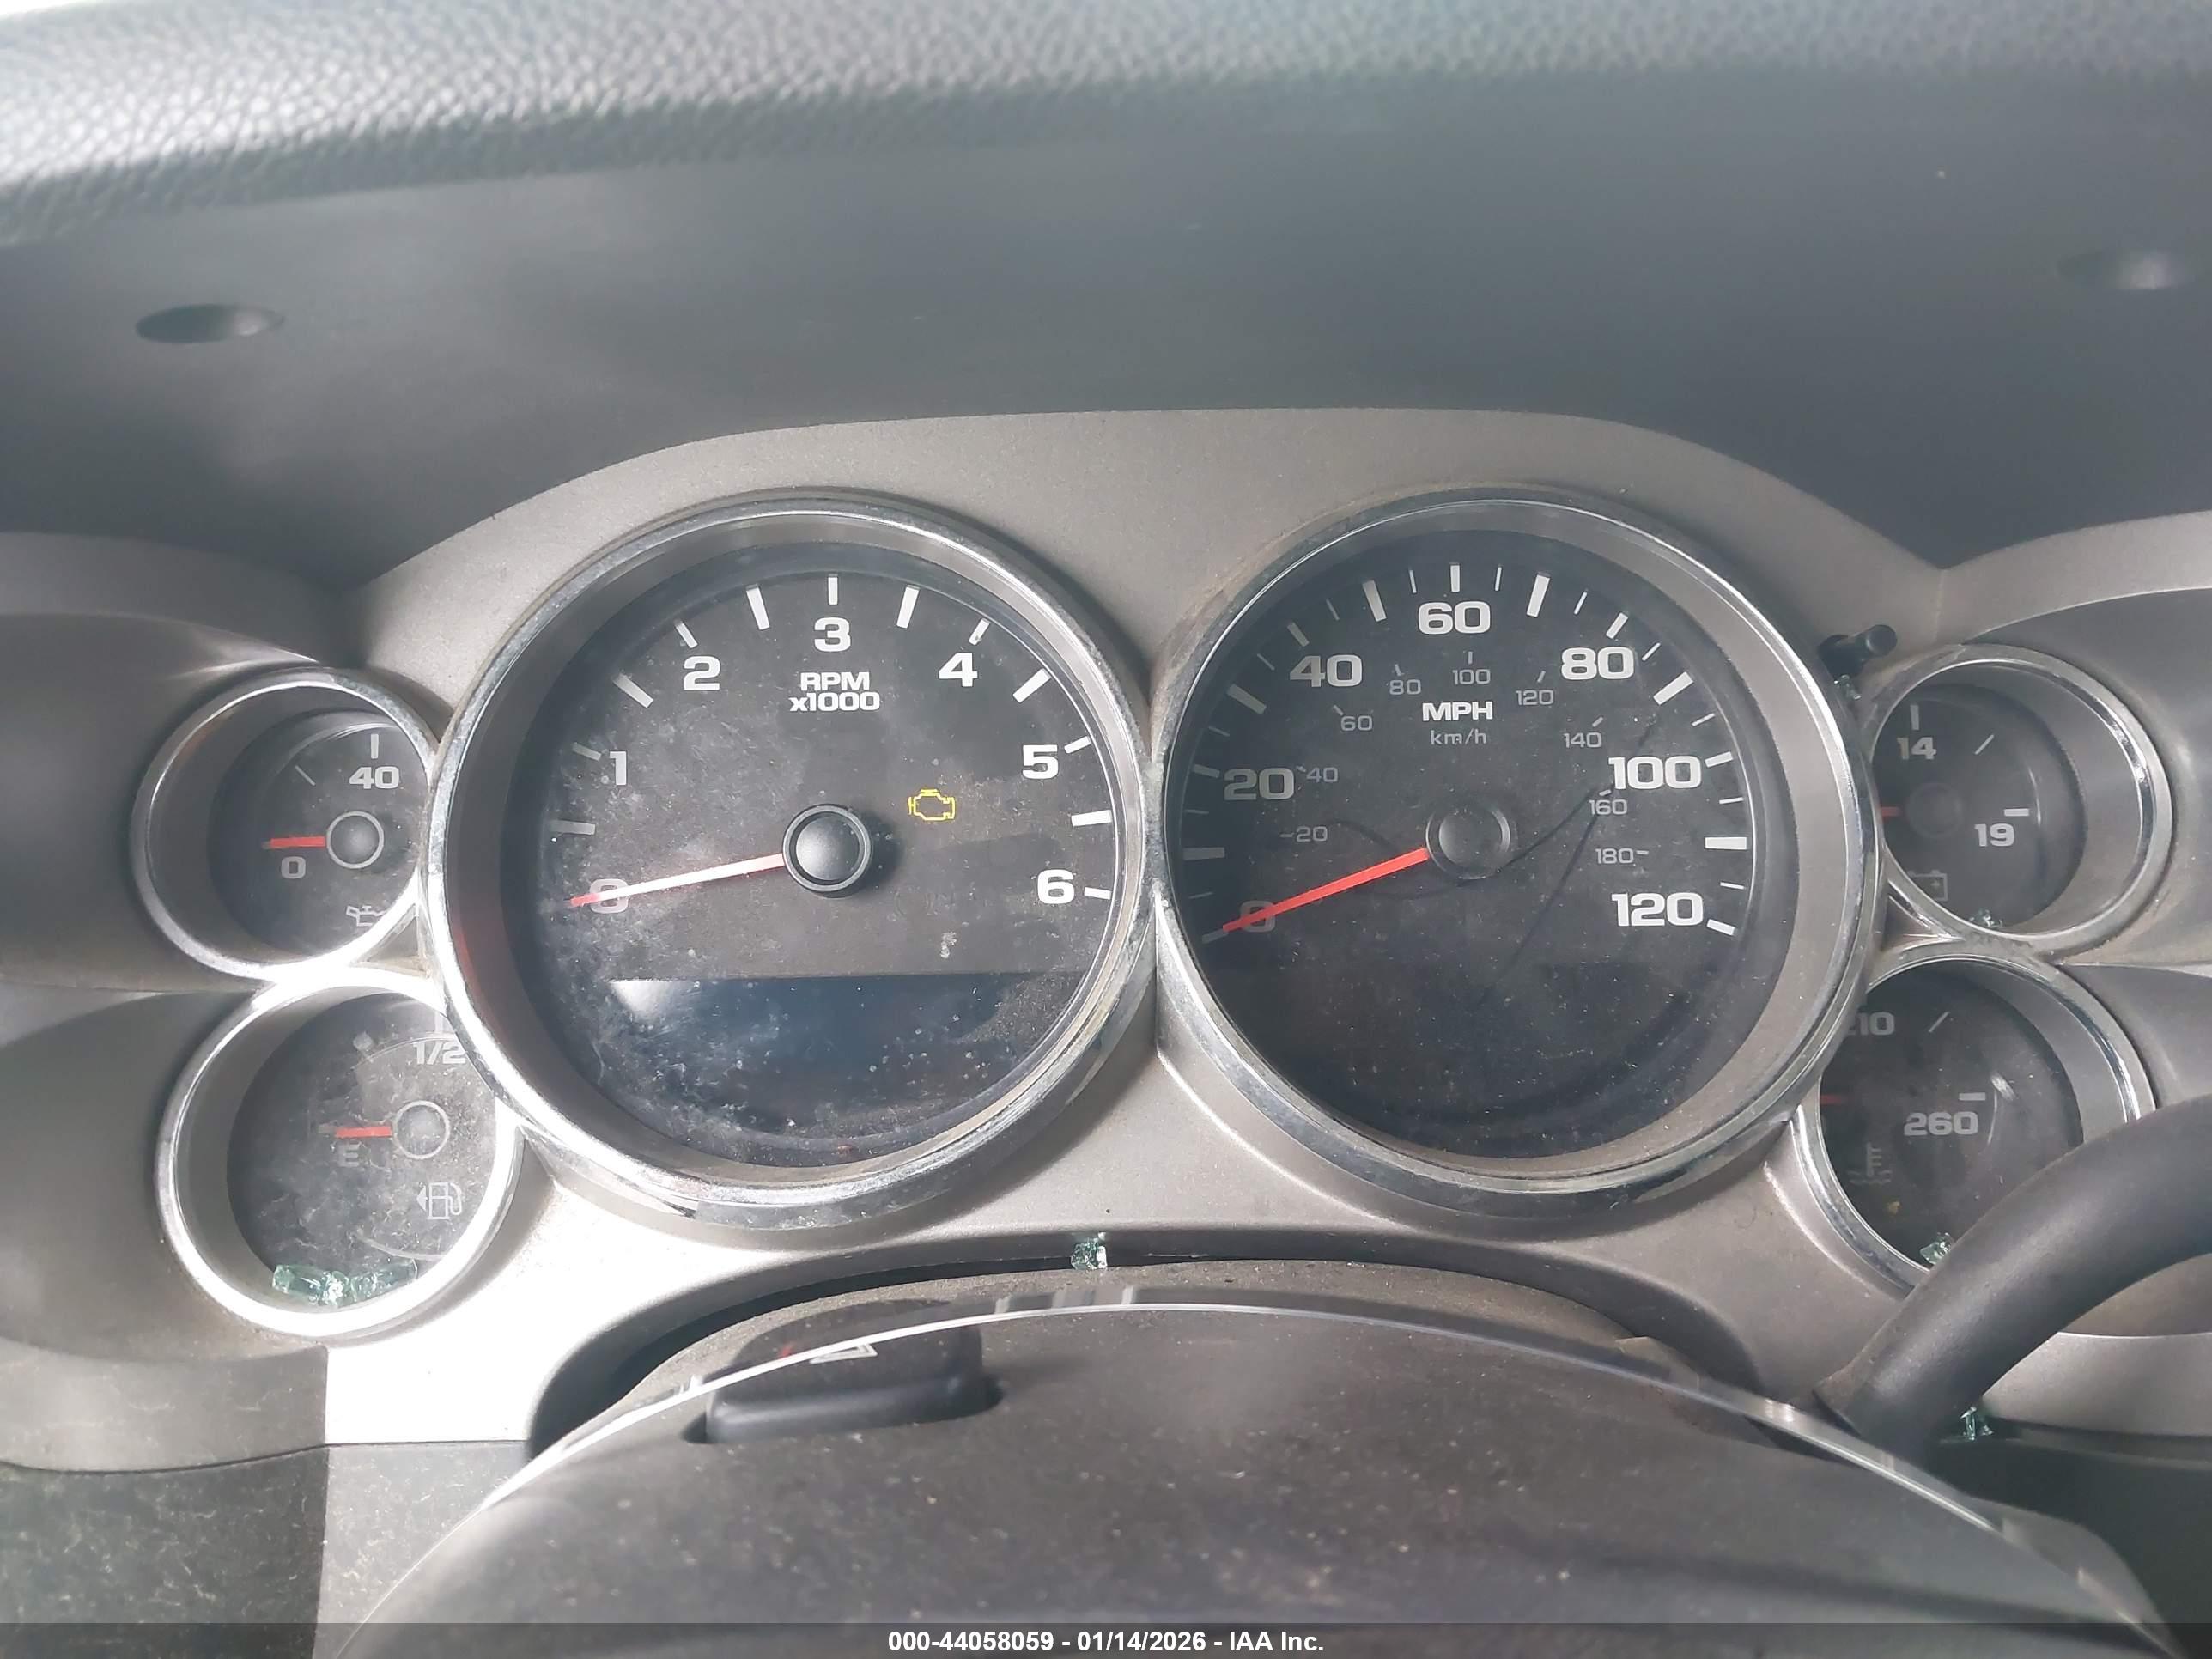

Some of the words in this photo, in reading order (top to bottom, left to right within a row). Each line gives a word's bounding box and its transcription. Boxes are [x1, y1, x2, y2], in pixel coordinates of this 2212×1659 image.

[1418, 601, 1492, 635] 60
[814, 617, 852, 652] 3
[684, 655, 720, 690] 2
[939, 653, 978, 687] 4
[1290, 654, 1363, 688] 40
[1561, 646, 1635, 680] 80
[800, 672, 870, 691] RPM
[1389, 678, 1422, 696] 80
[1452, 669, 1491, 686] 100
[789, 692, 881, 712] x1000
[1516, 690, 1554, 706] 120
[1340, 714, 1372, 732] 60
[1422, 702, 1493, 721] MPH
[1430, 728, 1487, 745] km/h
[1564, 732, 1601, 749] 140
[1897, 736, 1937, 760] 14
[610, 750, 627, 785] 1
[1022, 744, 1060, 779] 5
[1608, 755, 1702, 790] 100
[349, 766, 400, 790] 40
[1224, 767, 1295, 801] 20
[1305, 766, 1338, 783] 40
[1589, 799, 1627, 816] 160
[1296, 826, 1328, 842] 20
[1974, 823, 2014, 847] 19
[281, 856, 306, 879] 0
[1595, 848, 1634, 864] 180
[590, 878, 629, 914] 0
[1037, 869, 1075, 904] 6
[1239, 900, 1276, 933] 0
[1611, 893, 1704, 927] 120
[1848, 1012, 1896, 1036] 10
[413, 1041, 468, 1065] 1/2
[1903, 1111, 1979, 1136] 260
[337, 1142, 360, 1167] E
